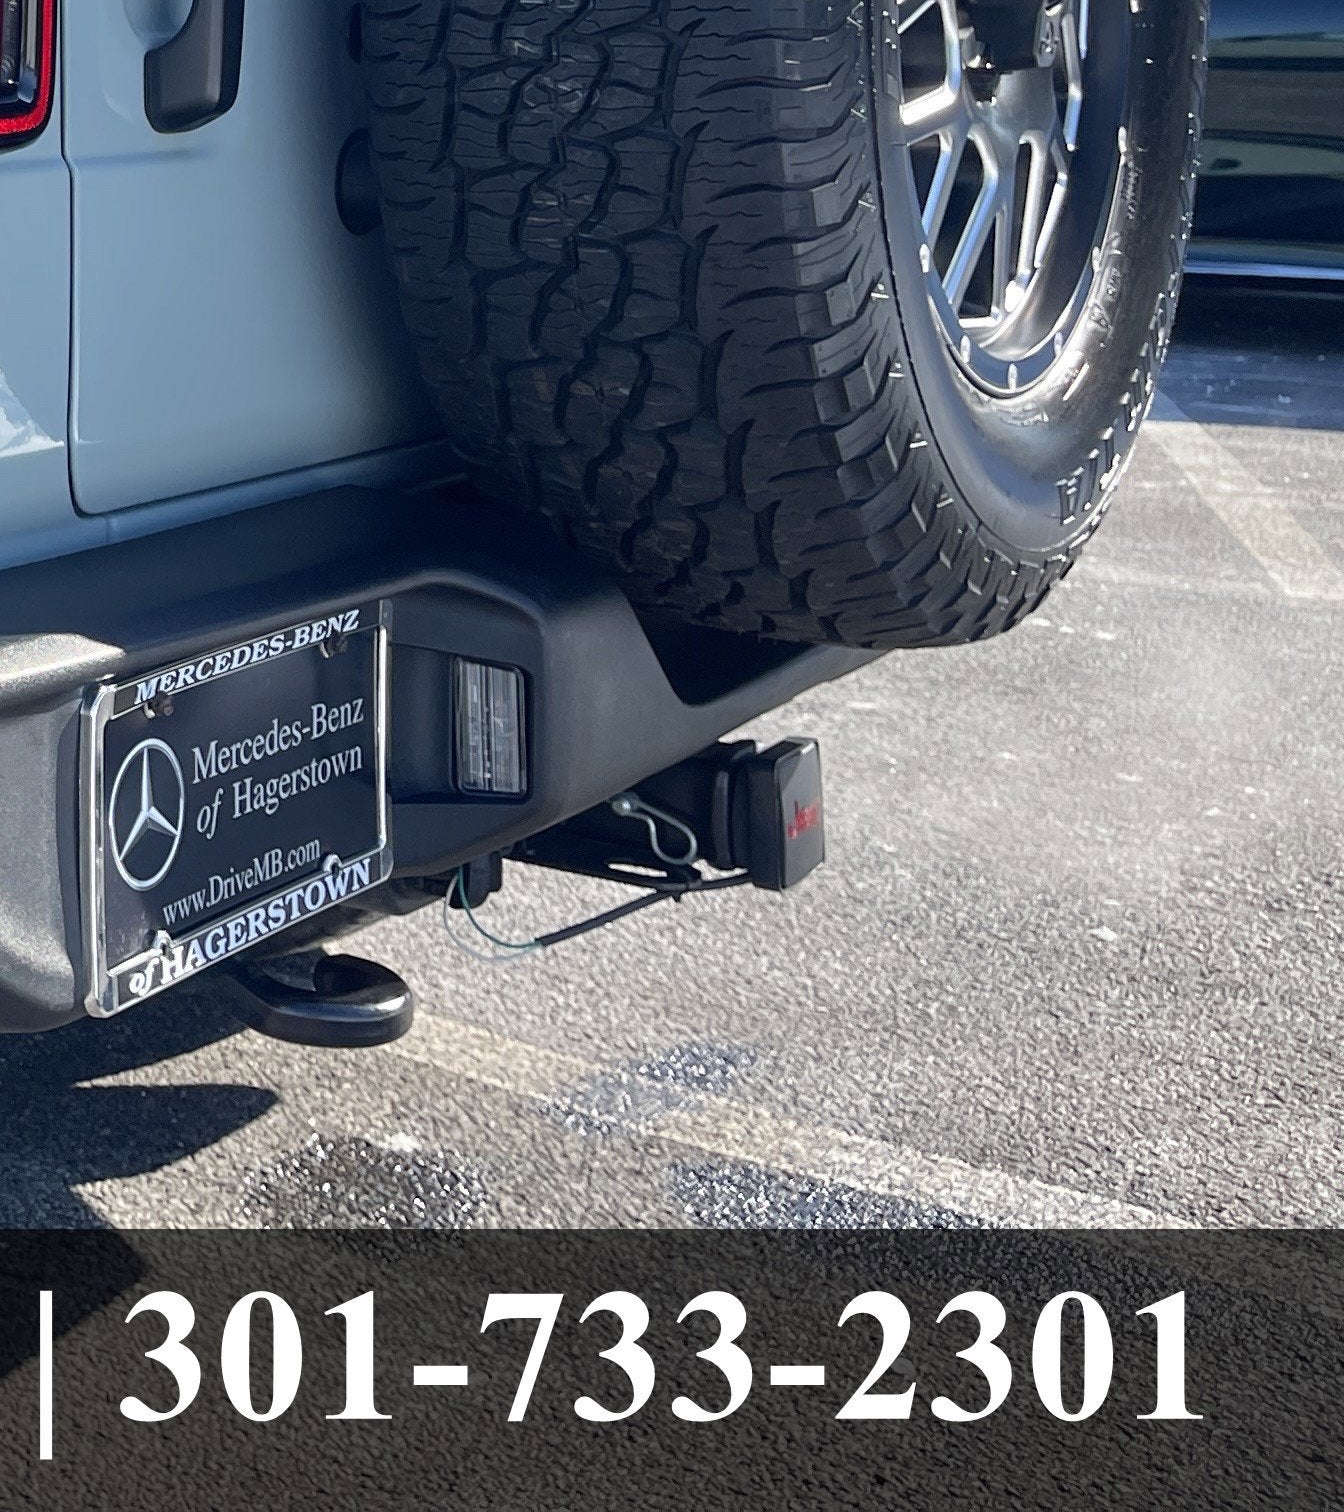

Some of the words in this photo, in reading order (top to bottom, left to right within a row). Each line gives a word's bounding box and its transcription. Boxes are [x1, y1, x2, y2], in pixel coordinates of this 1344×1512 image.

[132, 608, 361, 706] MERCEDES-BENZ
[191, 696, 365, 785] Mercedes-Benz
[196, 788, 224, 840] of
[231, 744, 363, 818] Hagerstown
[128, 956, 162, 998] of
[161, 858, 372, 986] HAGERSTOWN
[162, 835, 322, 927] www.DriveMB.com
